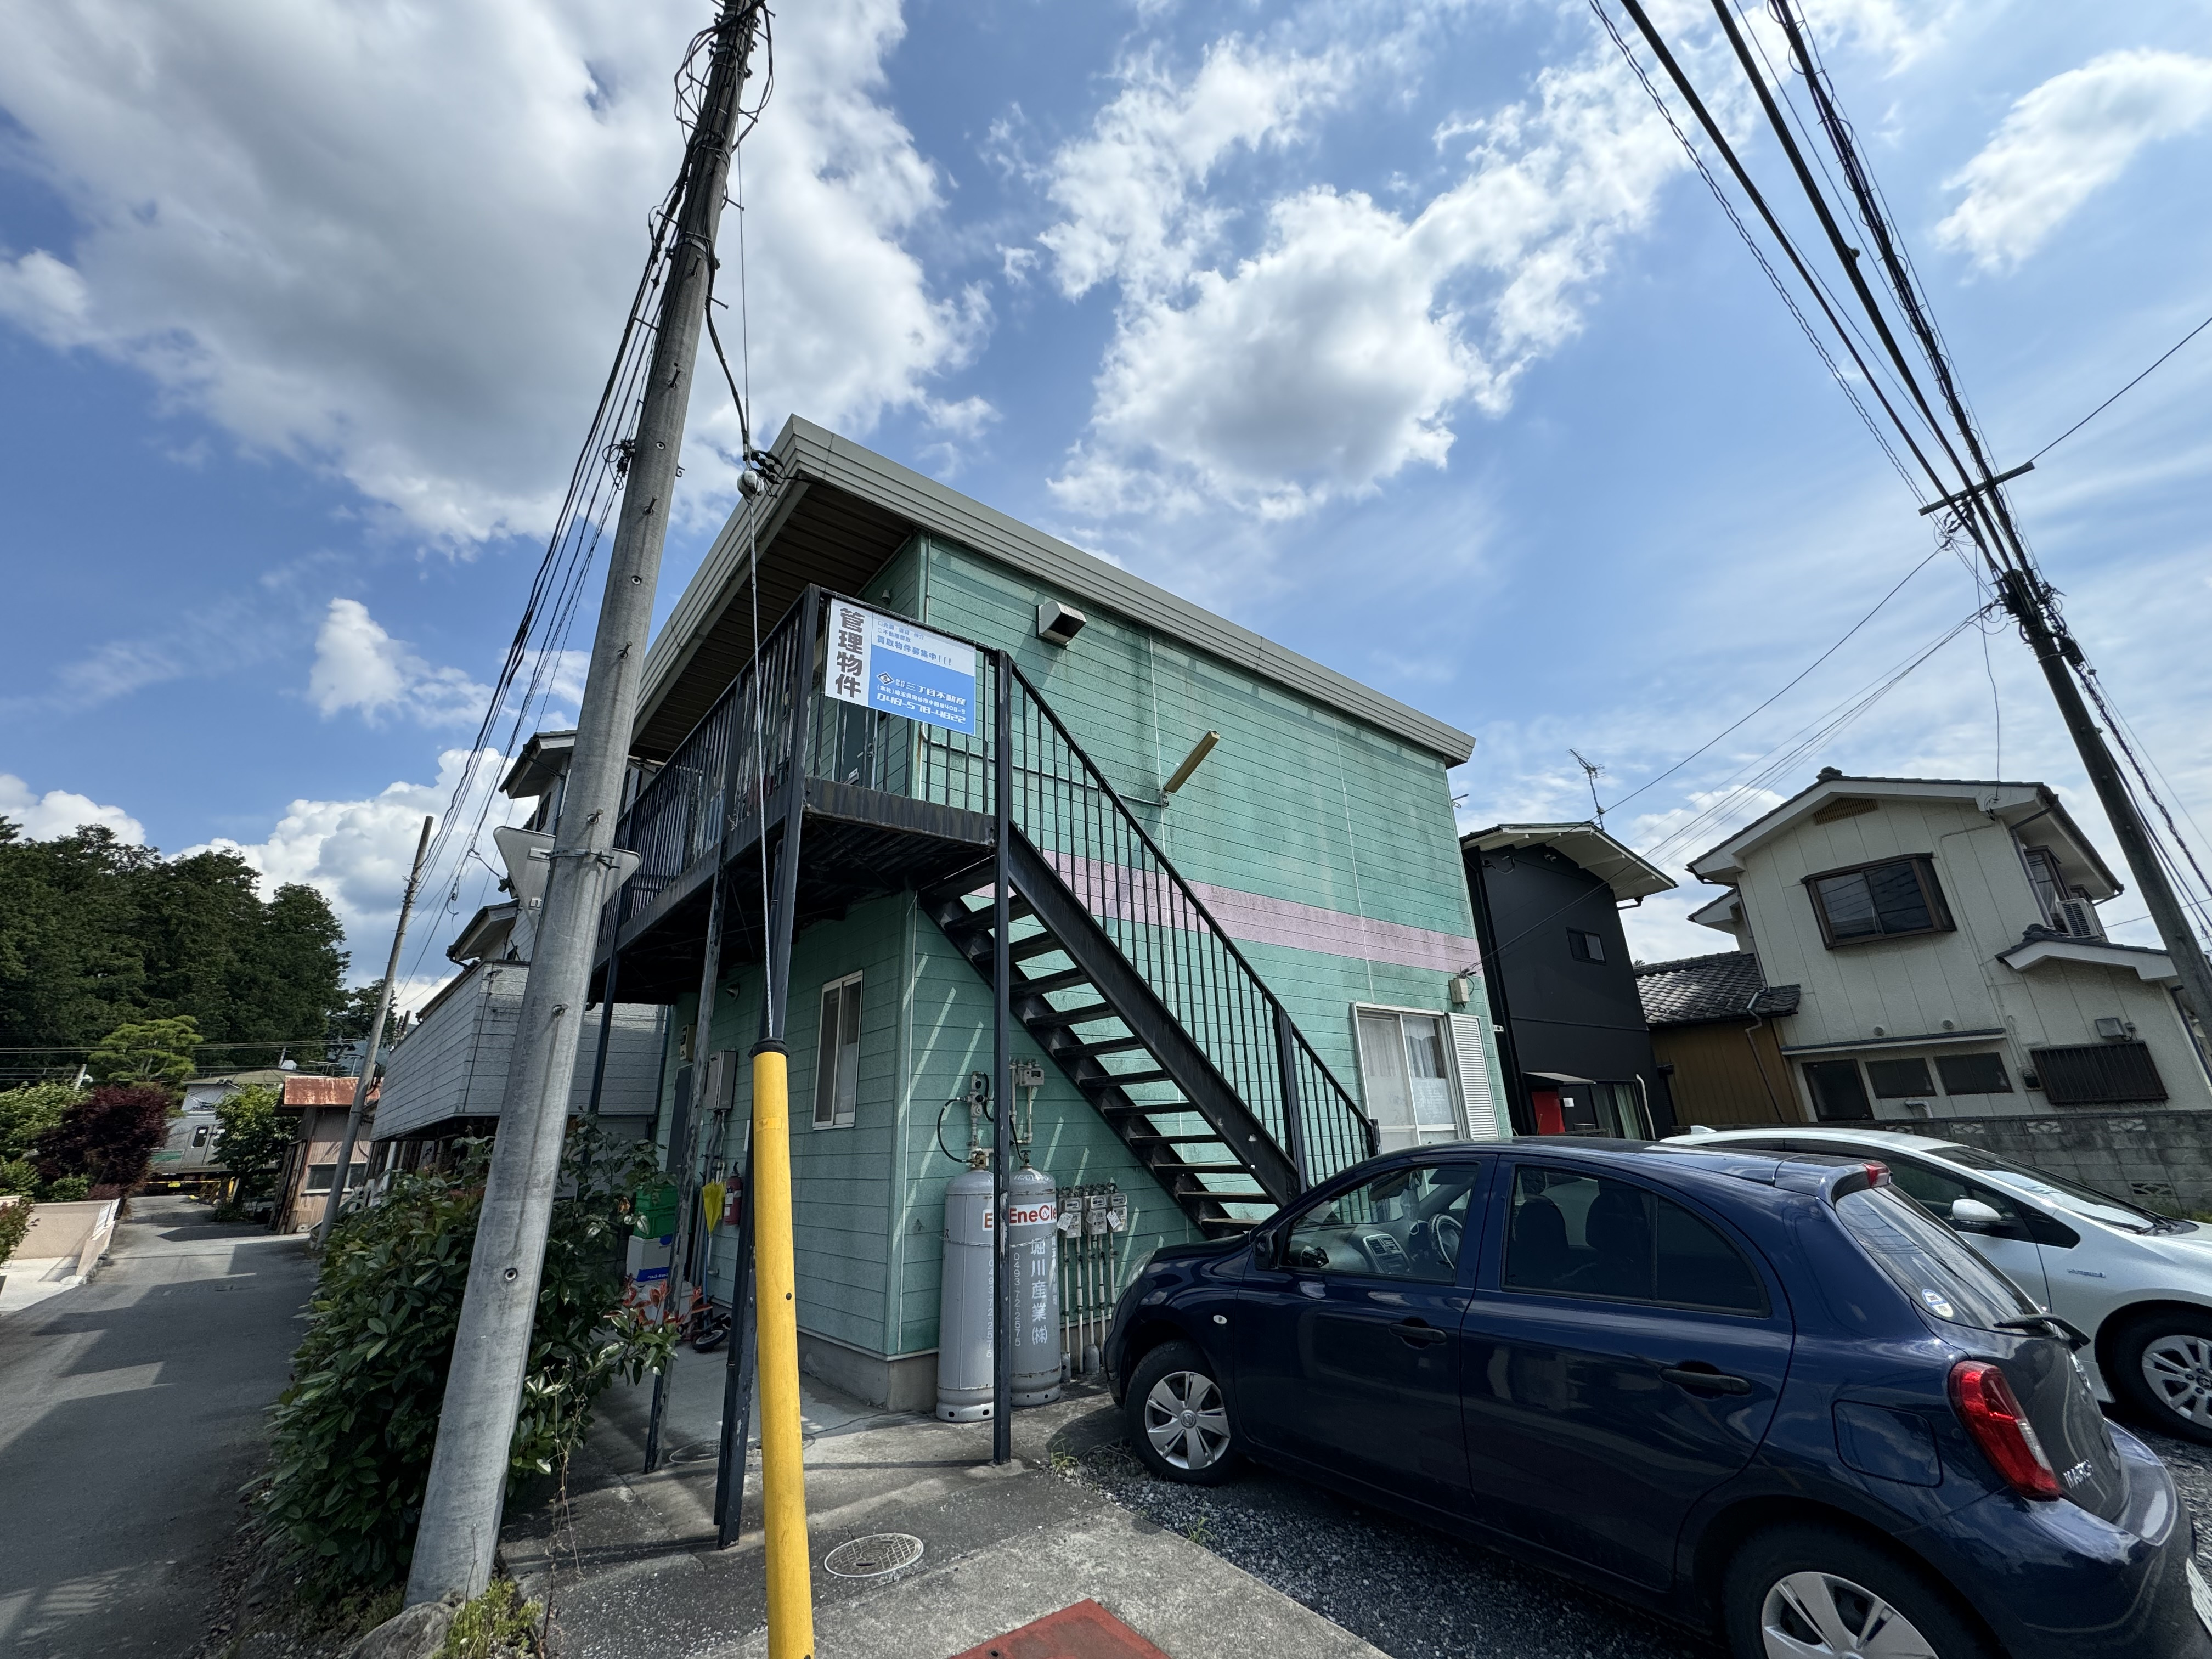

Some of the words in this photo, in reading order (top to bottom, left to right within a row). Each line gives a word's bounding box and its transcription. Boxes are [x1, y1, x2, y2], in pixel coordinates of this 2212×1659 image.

[836, 608, 865, 698] 管理物件
[877, 693, 966, 724] 048-578-4822
